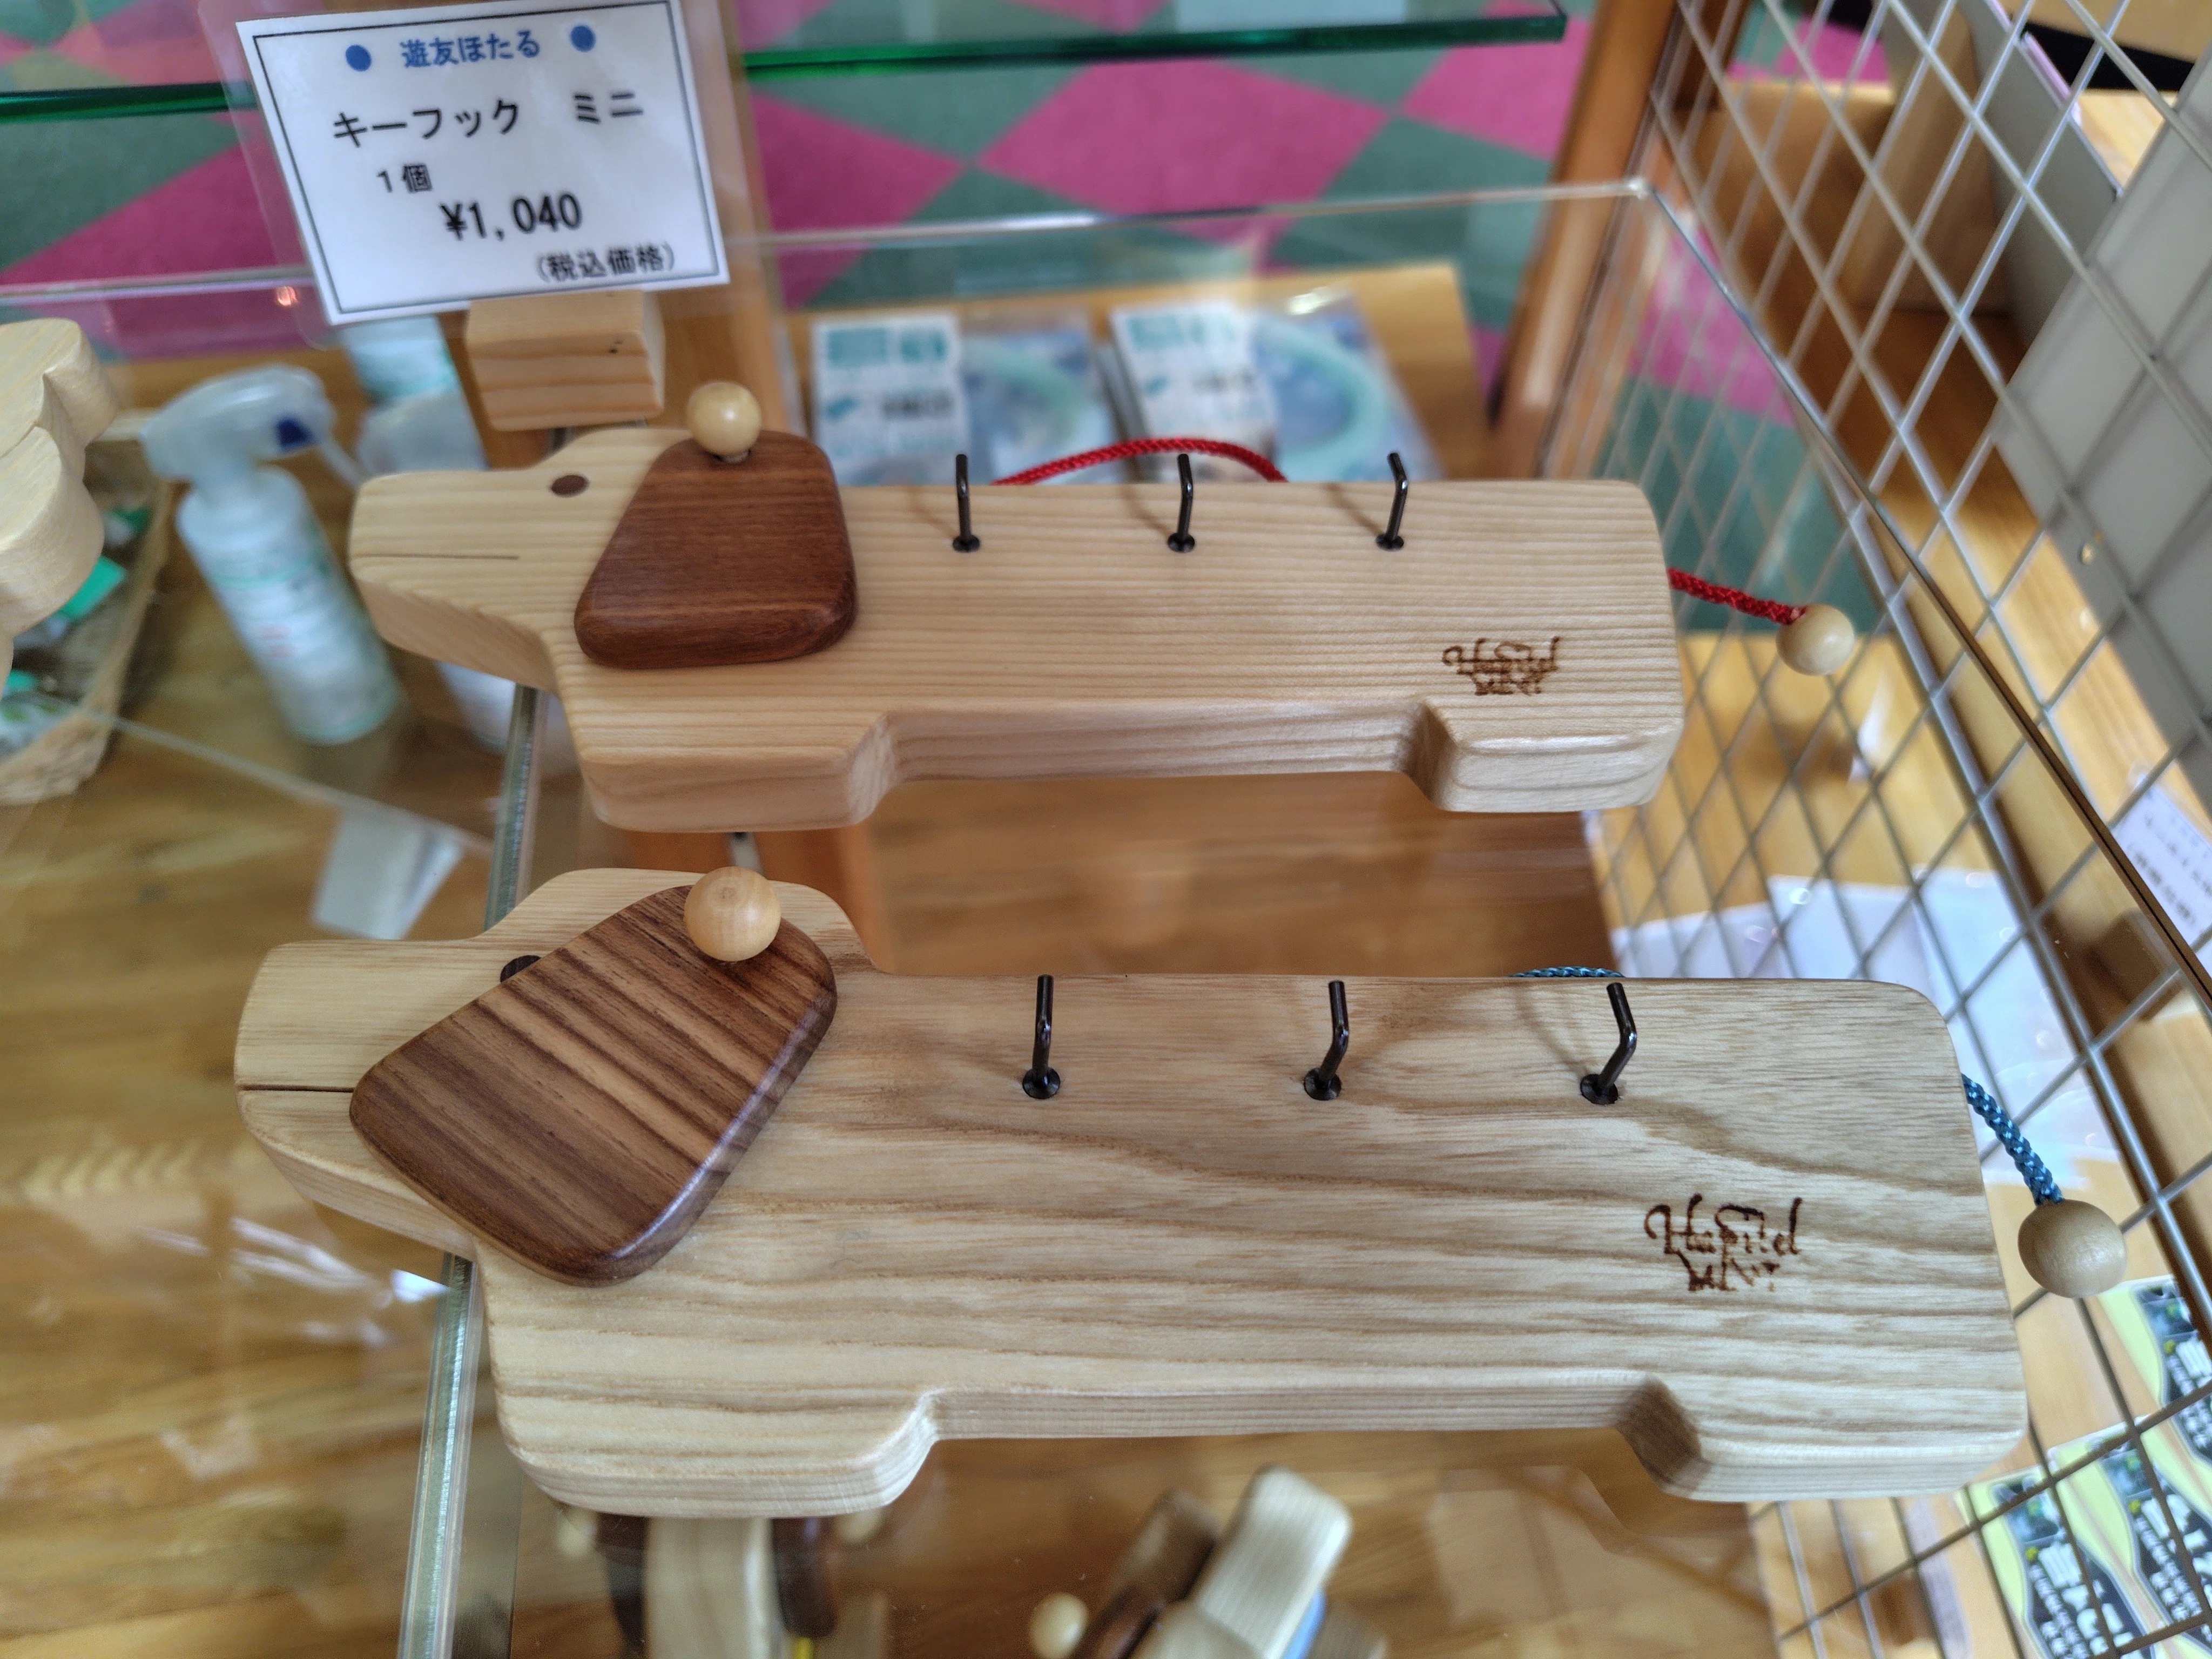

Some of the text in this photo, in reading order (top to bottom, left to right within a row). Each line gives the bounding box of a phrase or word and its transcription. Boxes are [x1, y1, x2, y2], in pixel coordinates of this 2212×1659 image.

[400, 29, 540, 68] 遊友ほたる
[333, 91, 644, 147] キーフック ミニ
[440, 193, 581, 241] ¥1,040
[537, 244, 675, 284] (税込価格)
